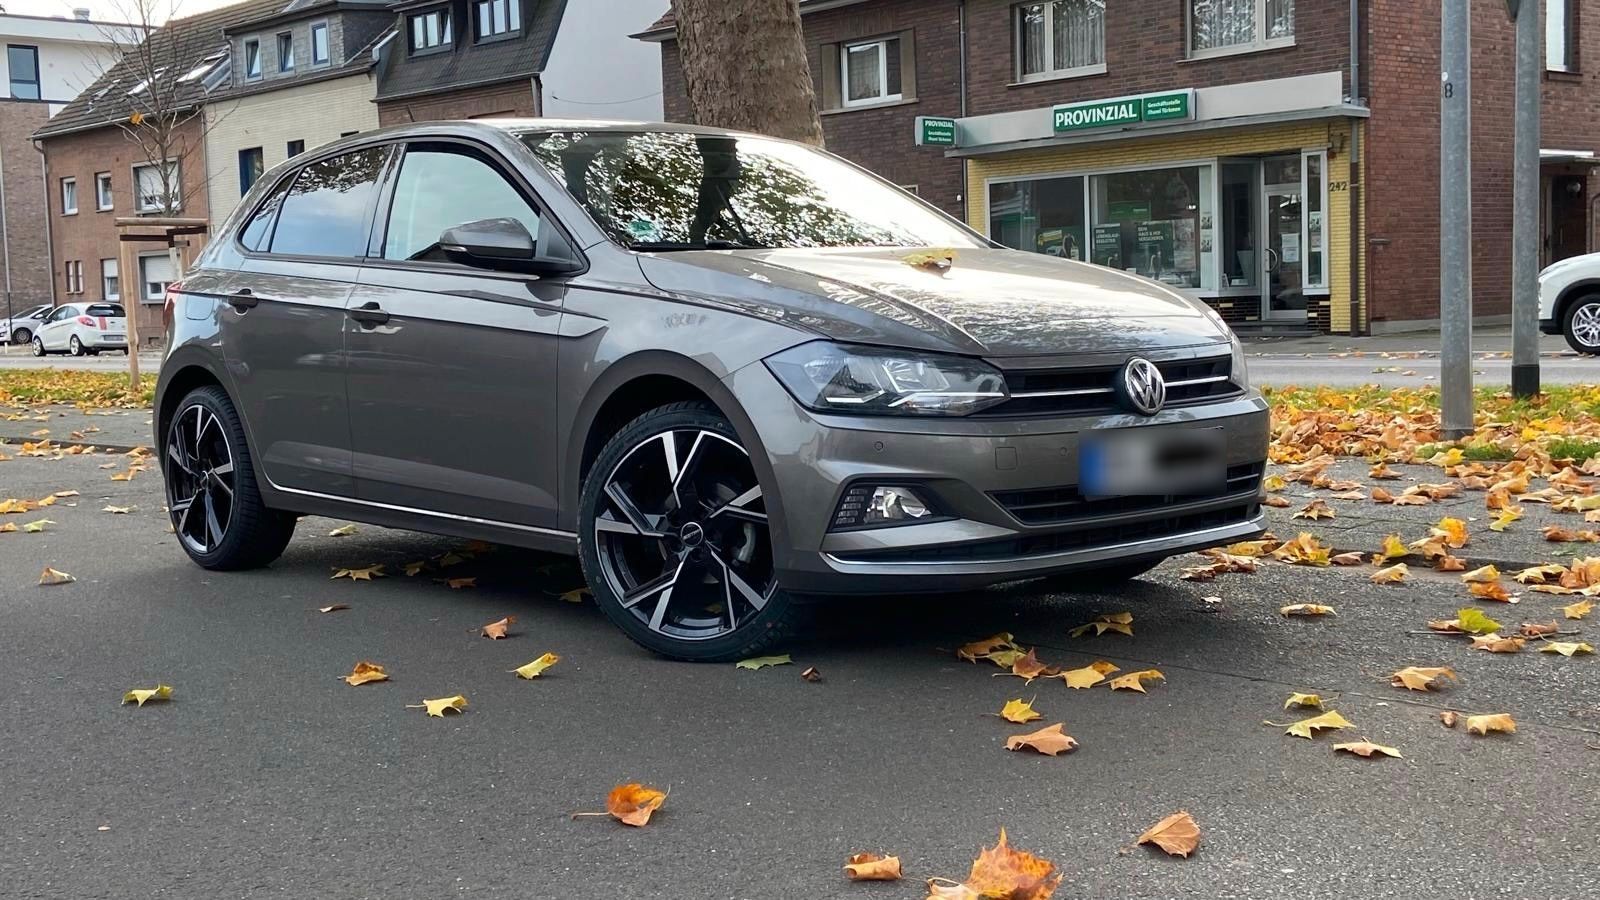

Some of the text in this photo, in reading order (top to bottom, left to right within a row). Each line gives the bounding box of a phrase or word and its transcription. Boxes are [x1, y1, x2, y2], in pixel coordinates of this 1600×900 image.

[1444, 82, 1453, 99] 8
[1055, 102, 1137, 127] PROVINZIAL
[925, 120, 953, 128] PROVINZIAL
[1328, 181, 1347, 191] 242
